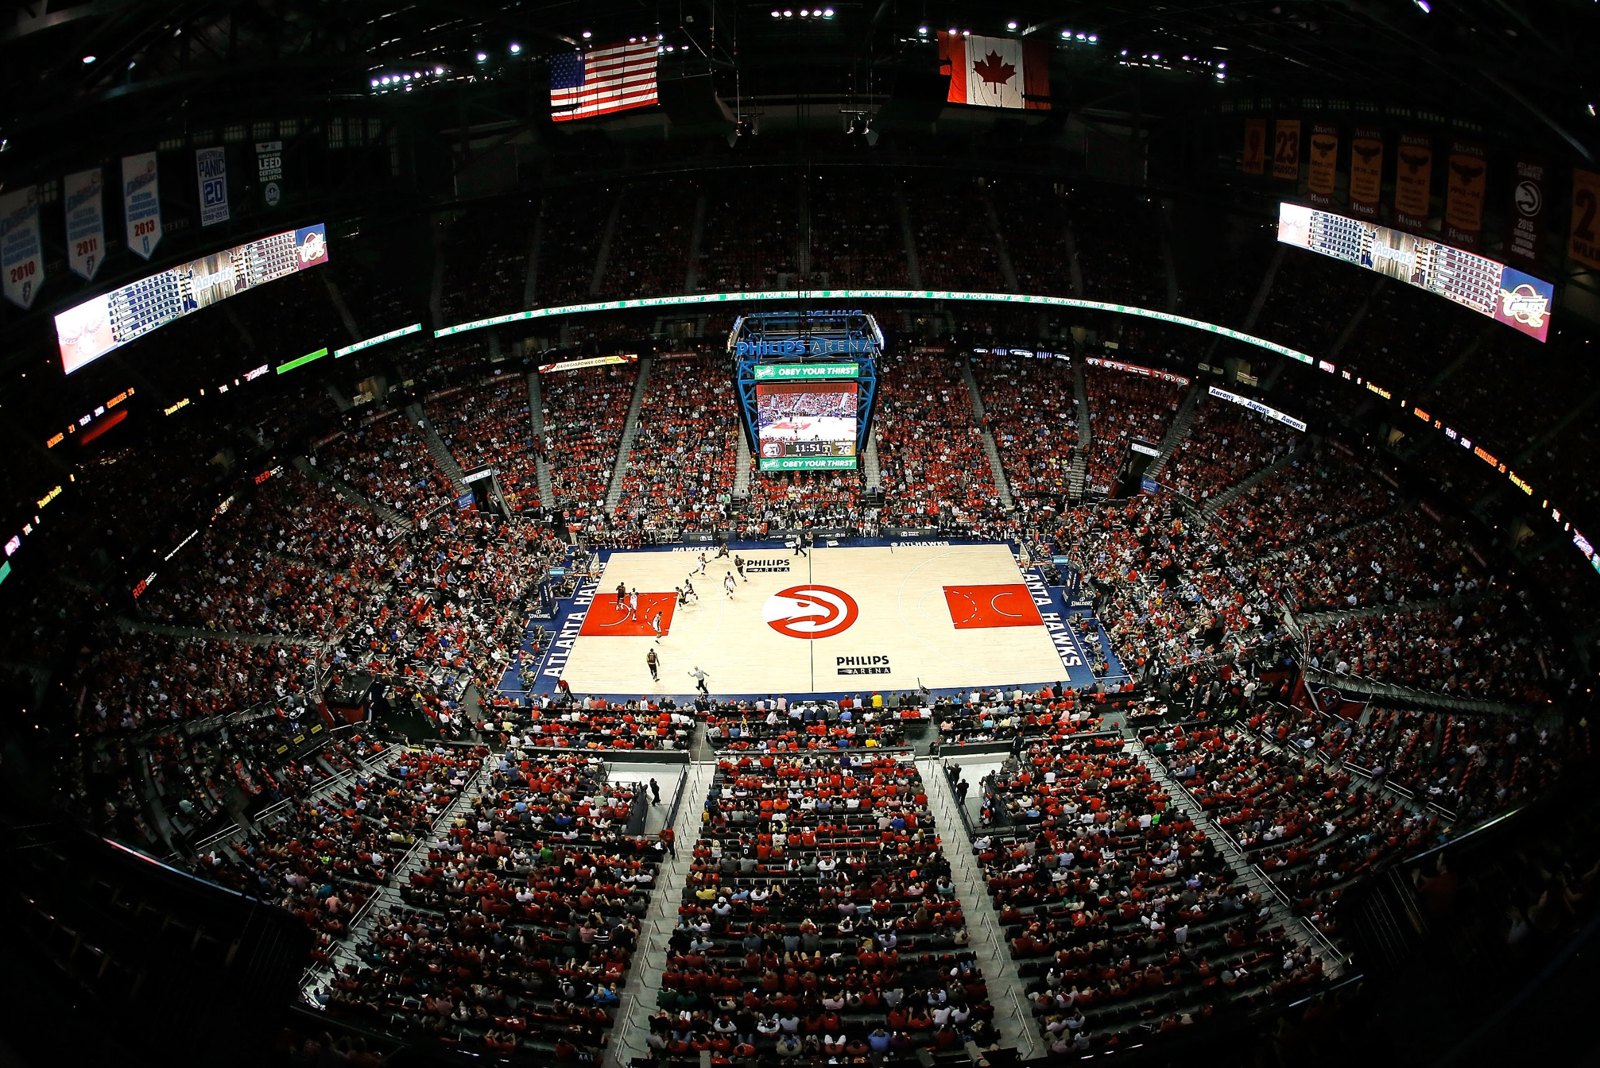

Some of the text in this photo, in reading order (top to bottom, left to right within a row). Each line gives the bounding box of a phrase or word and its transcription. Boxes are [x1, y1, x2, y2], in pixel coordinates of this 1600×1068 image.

[1275, 131, 1298, 164] 23
[199, 159, 225, 178] PANIC
[259, 157, 282, 170] LEED
[206, 181, 222, 204] 20
[134, 219, 155, 237] 2013
[1517, 218, 1534, 232] 2015
[77, 238, 97, 256] 2011
[10, 261, 35, 283] 2010
[736, 340, 873, 356] PHILIPS ARENA
[778, 367, 801, 376] OBEY
[802, 367, 825, 375] YOUR
[827, 366, 856, 375] THIRST
[1434, 420, 1441, 429] 21
[795, 444, 821, 453] 11:51
[838, 446, 852, 455] 26
[804, 460, 827, 468] YOUR
[828, 459, 855, 467] THIRST
[746, 559, 790, 567] PHILIPS
[1013, 553, 1083, 668] ALANTA HAWKS
[543, 562, 607, 678] ATLANTA HAWS
[836, 655, 889, 666] PHILIPS
[853, 667, 890, 675] ARENA
